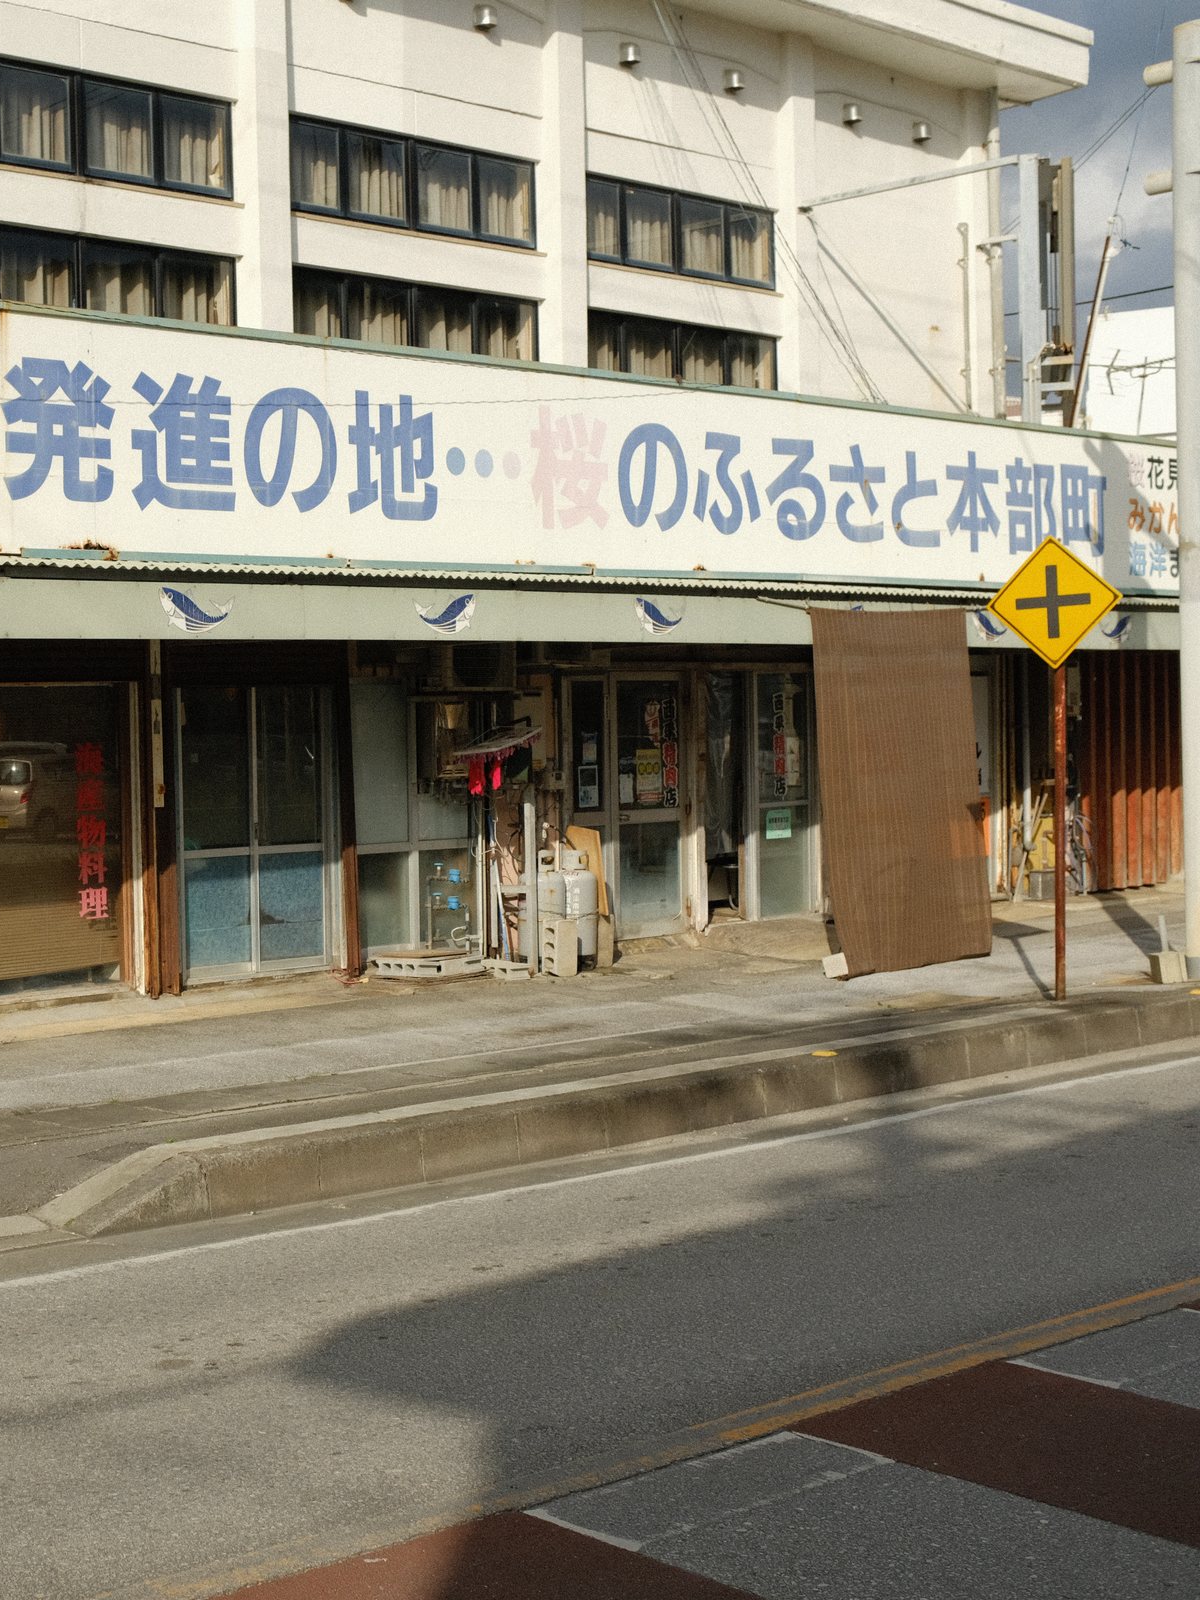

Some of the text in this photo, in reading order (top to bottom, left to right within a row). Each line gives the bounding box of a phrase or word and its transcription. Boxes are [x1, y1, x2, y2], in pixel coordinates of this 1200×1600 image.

[1128, 497, 1181, 534] みかん
[75, 741, 110, 920] 海産物料理
